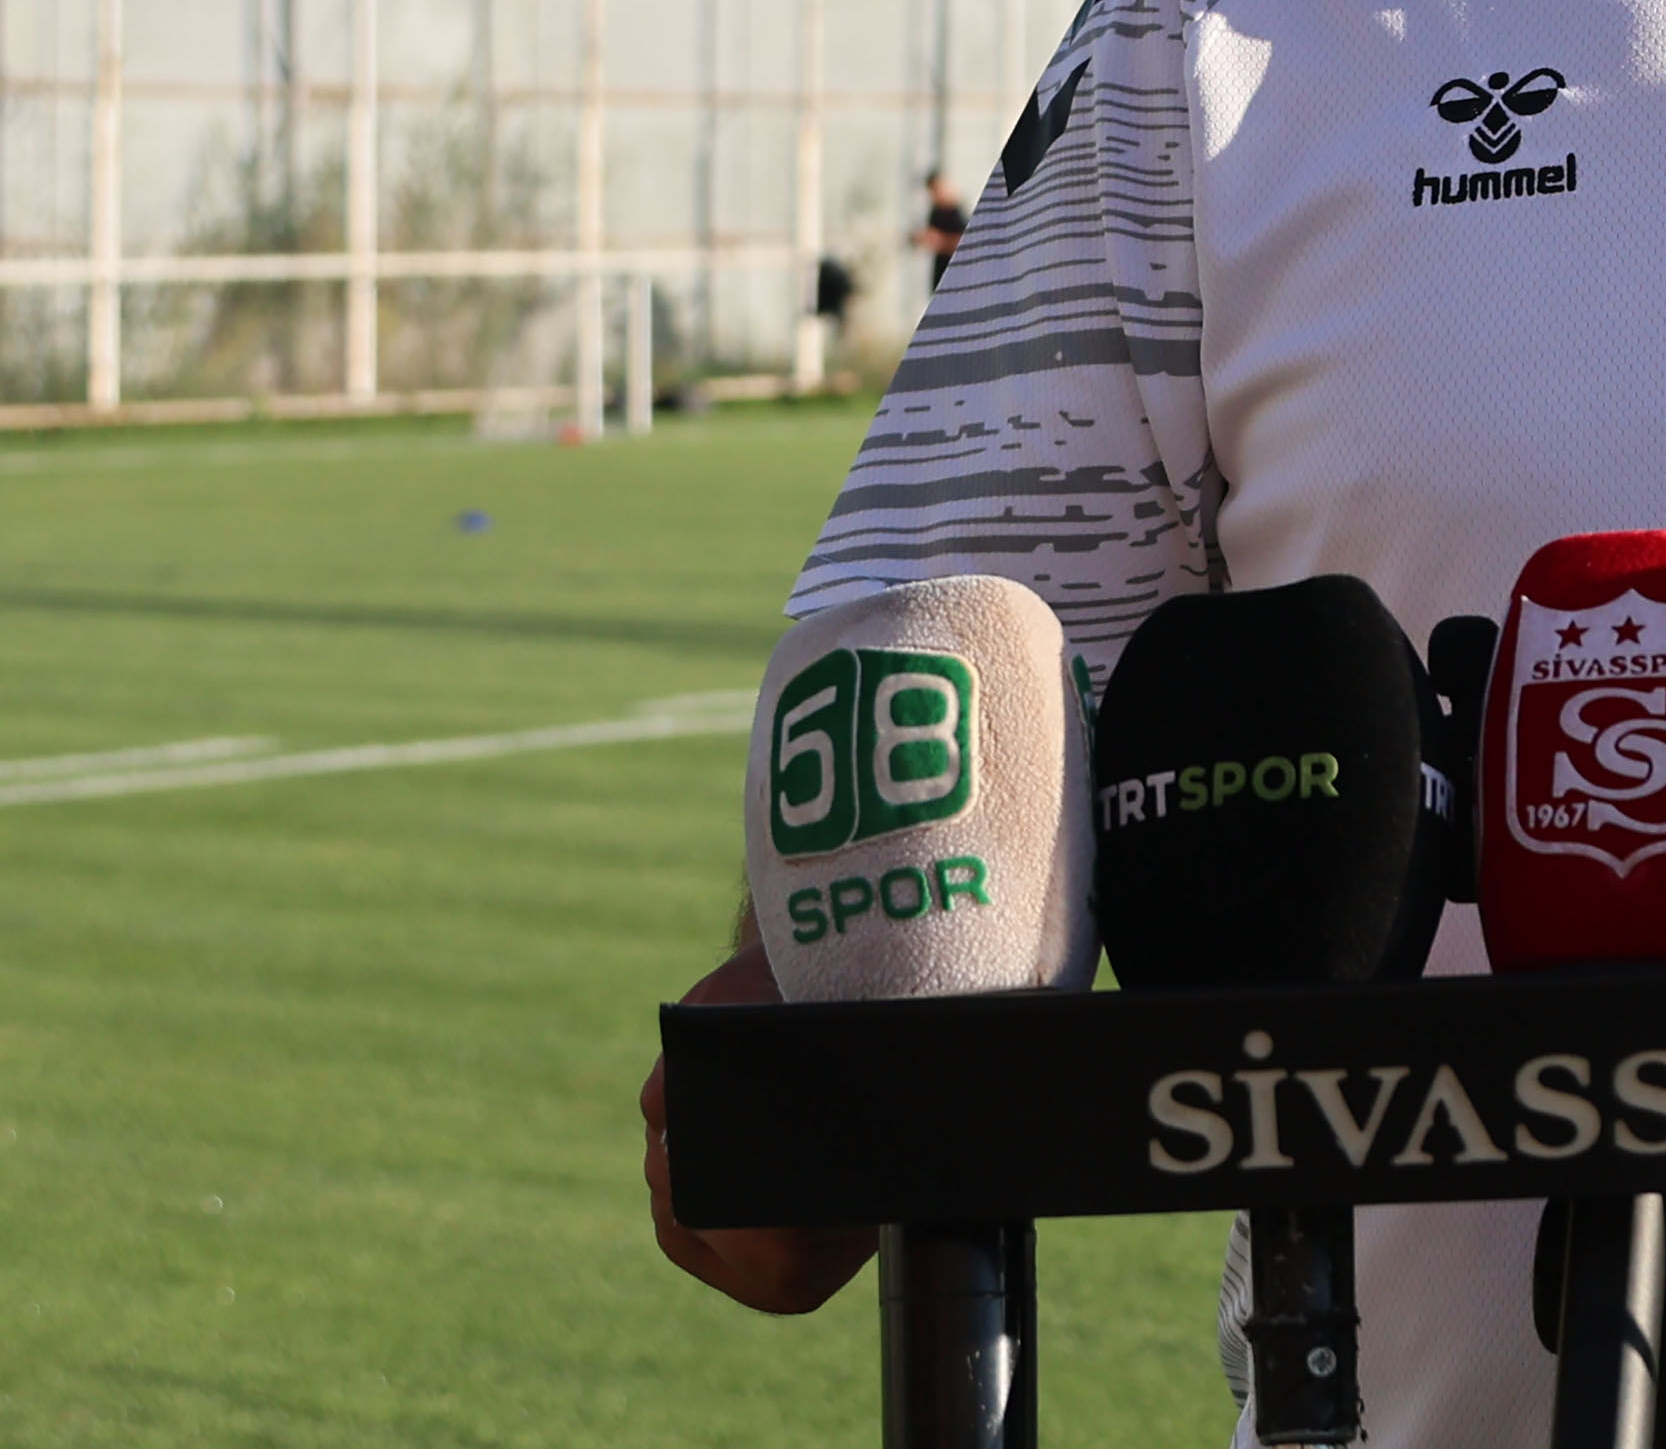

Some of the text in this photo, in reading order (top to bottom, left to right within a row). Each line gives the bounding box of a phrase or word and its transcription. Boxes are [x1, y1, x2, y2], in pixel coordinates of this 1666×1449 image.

[1413, 152, 1577, 207] hummel
[779, 672, 961, 829] 58
[1525, 802, 1588, 830] 1967
[787, 855, 993, 944] SPOR
